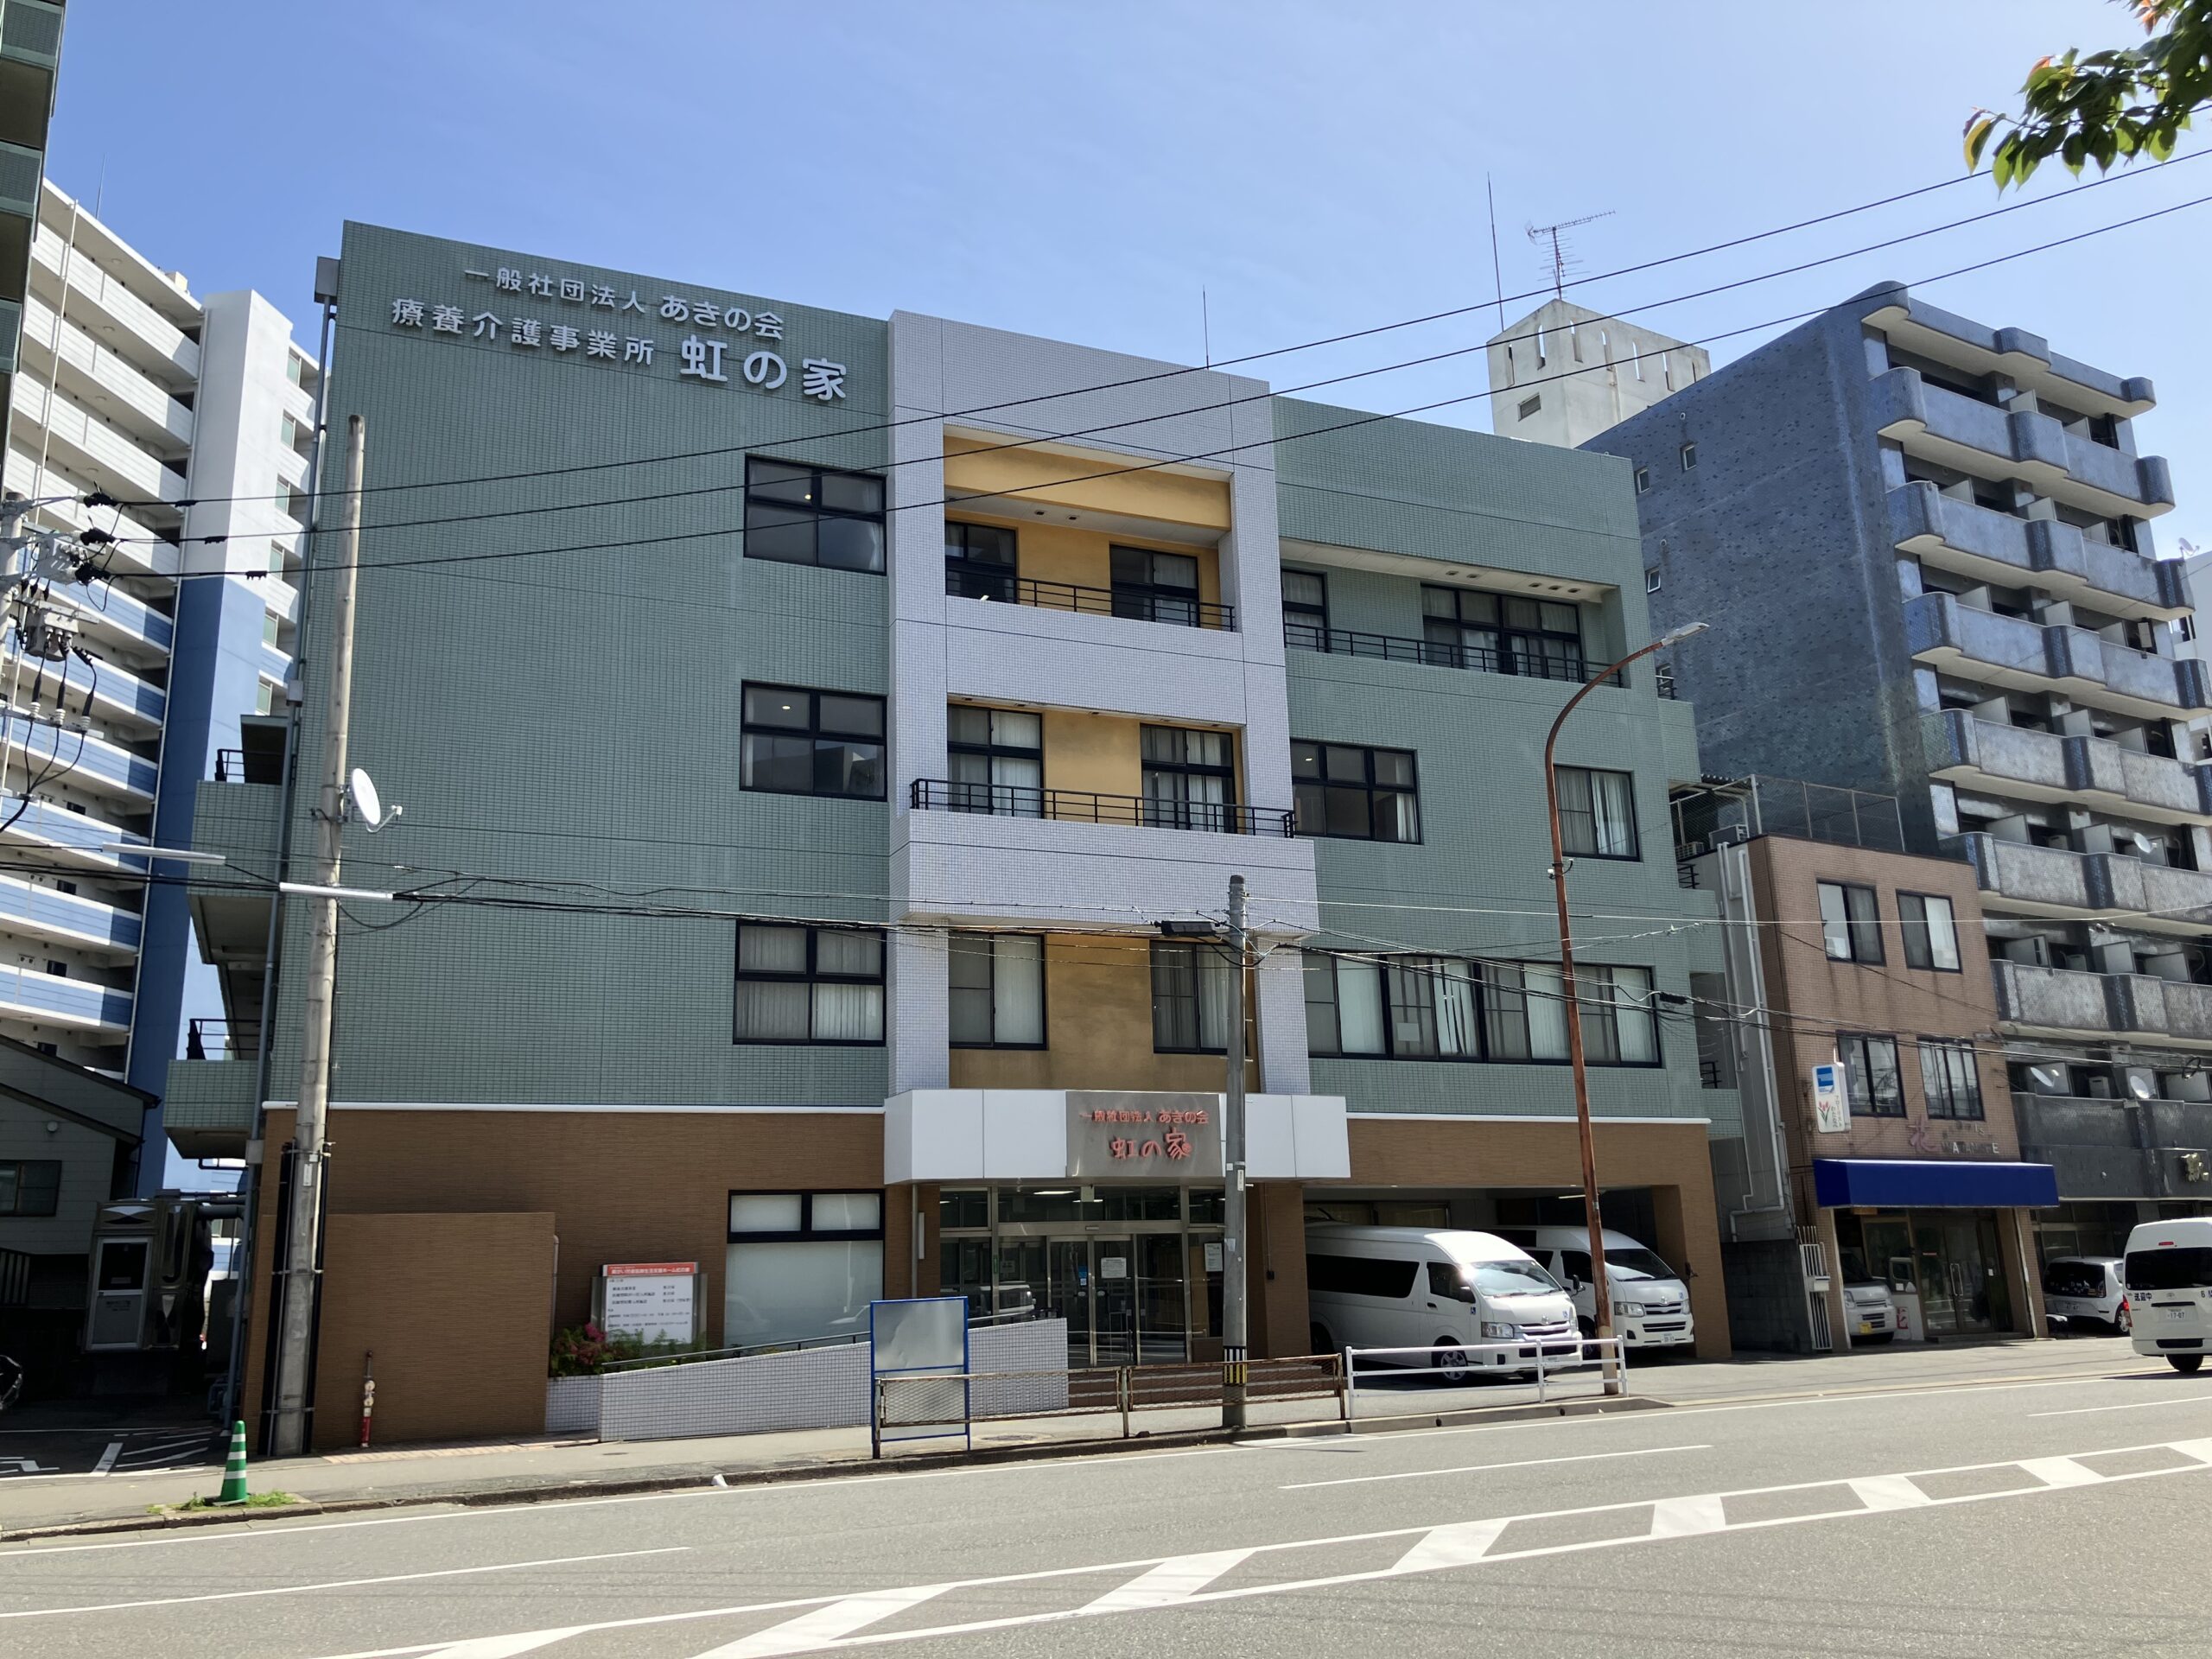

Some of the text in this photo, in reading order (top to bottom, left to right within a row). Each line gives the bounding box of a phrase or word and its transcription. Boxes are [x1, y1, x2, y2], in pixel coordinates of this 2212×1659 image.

[464, 266, 785, 341] 一般社団法人 あきの会
[391, 297, 847, 402] 療養介護事業所 虹の家
[1080, 1109, 1209, 1124] 一般社団法人 あきの会
[1110, 1128, 1192, 1160] 虹の家
